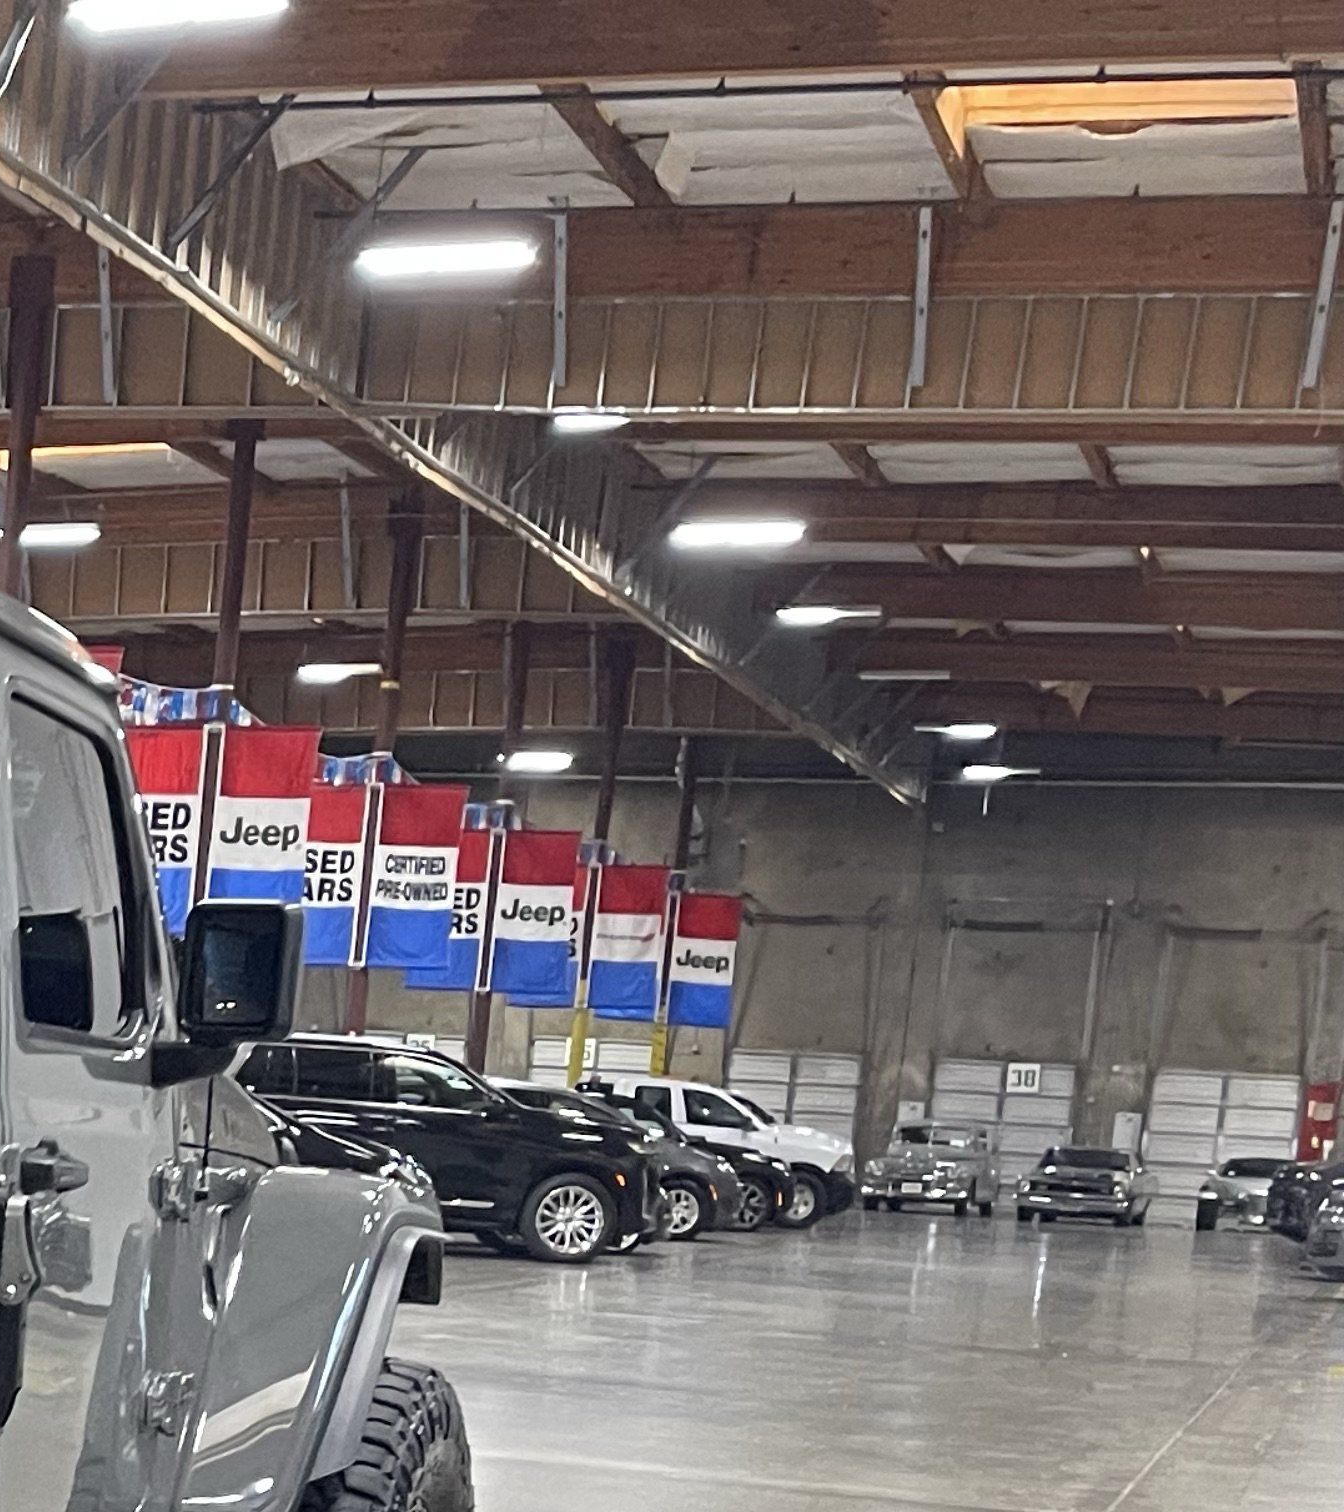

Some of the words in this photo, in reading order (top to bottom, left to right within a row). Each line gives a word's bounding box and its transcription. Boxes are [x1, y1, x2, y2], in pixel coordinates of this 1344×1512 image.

[143, 801, 192, 830] ED
[219, 816, 300, 851] Jeep
[154, 833, 188, 863] RS
[305, 848, 355, 874] SED
[304, 877, 354, 902] ARS
[454, 888, 481, 910] ED
[452, 913, 478, 935] RS
[500, 898, 566, 927] Jeep
[675, 949, 730, 974] Jeep
